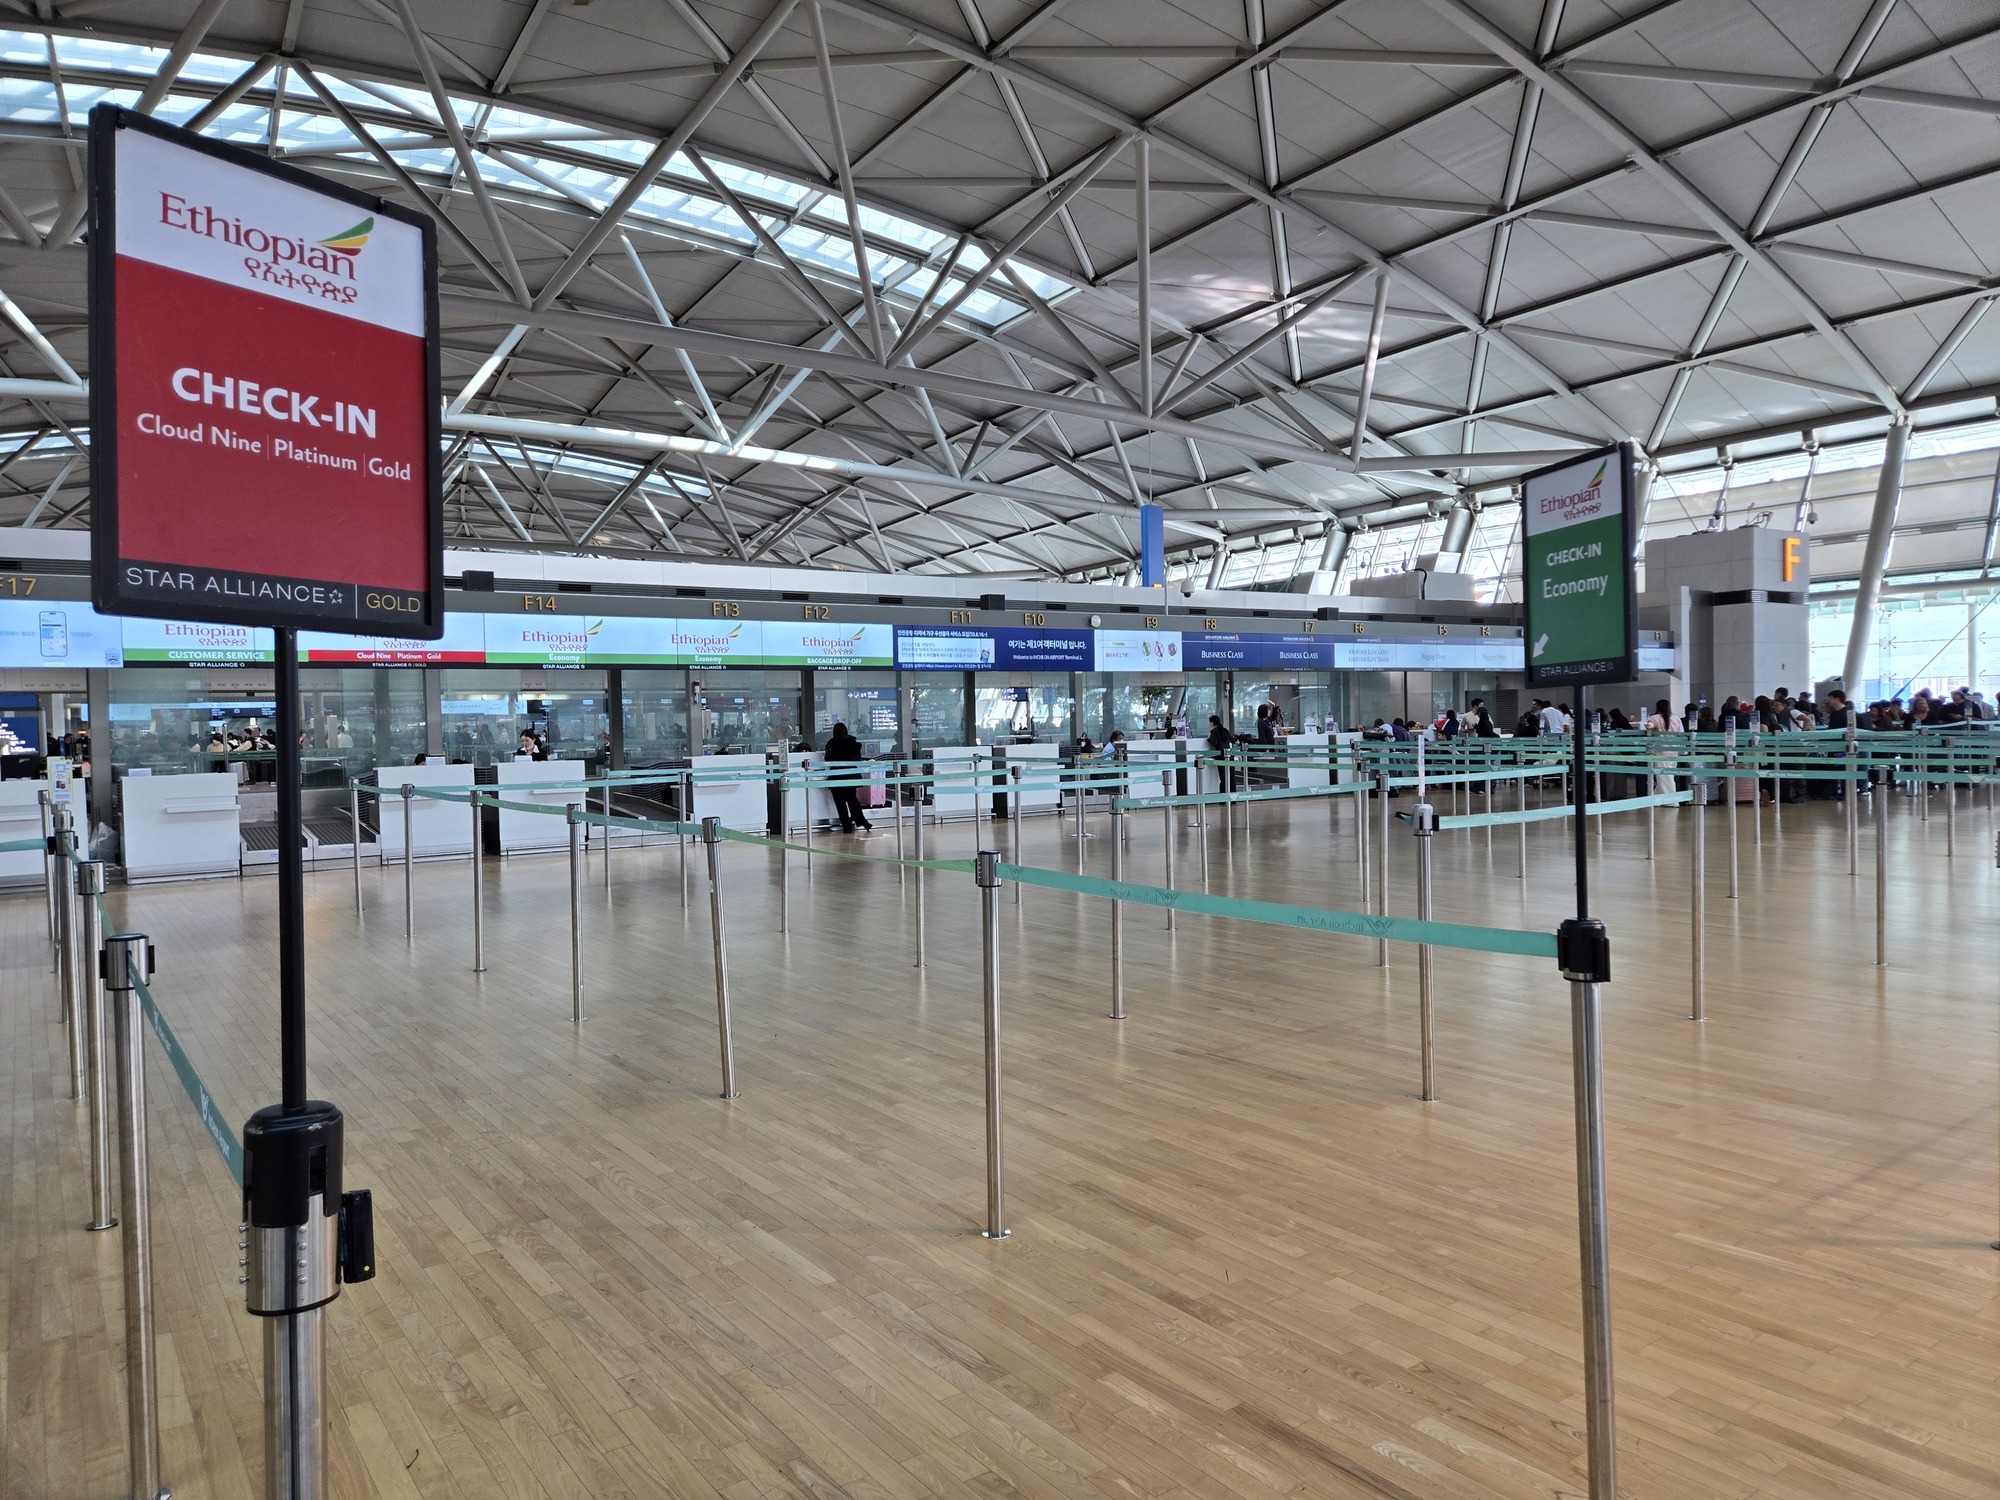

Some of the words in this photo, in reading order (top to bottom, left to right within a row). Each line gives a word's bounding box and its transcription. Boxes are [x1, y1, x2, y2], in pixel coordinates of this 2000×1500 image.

[159, 191, 357, 281] Ethiopian
[172, 367, 376, 438] CHECK-IN
[137, 413, 203, 442] Cloud
[212, 426, 262, 453] Nine
[275, 439, 357, 471] Platinum
[368, 457, 411, 481] Gold
[1540, 487, 1601, 514] Ethiopian
[1546, 542, 1601, 566] CHECK-IN
[1783, 537, 1800, 582] F
[126, 567, 195, 591] STAR
[204, 576, 326, 604] ALLIANCE
[365, 592, 421, 613] GOLD
[1543, 575, 1608, 598] Economy
[524, 595, 557, 611] F14
[712, 602, 740, 617] F13
[804, 605, 829, 620] F12
[951, 610, 972, 623] F11
[1024, 613, 1044, 626] F10
[1146, 616, 1158, 629] F9
[1204, 618, 1217, 630] F8
[1303, 621, 1315, 632] F7
[1354, 623, 1364, 633] F6
[164, 624, 246, 638] Ethiopian
[522, 630, 588, 645] Ethiopian
[671, 633, 729, 647] Ethiopian
[802, 636, 853, 649] Ethiopian
[1008, 639, 1026, 649] 여기는
[168, 651, 224, 659] CUSTOMER
[226, 652, 265, 660] SERVICE
[549, 653, 580, 662] Economy
[695, 655, 722, 664] Economy
[1201, 650, 1226, 658] BUSINESS
[1227, 650, 1244, 659] CLASS
[1279, 651, 1302, 659] BUSINESS
[1303, 652, 1319, 660] CLASS
[1541, 666, 1561, 677] STAR
[1564, 661, 1606, 675] ALLIANCE
